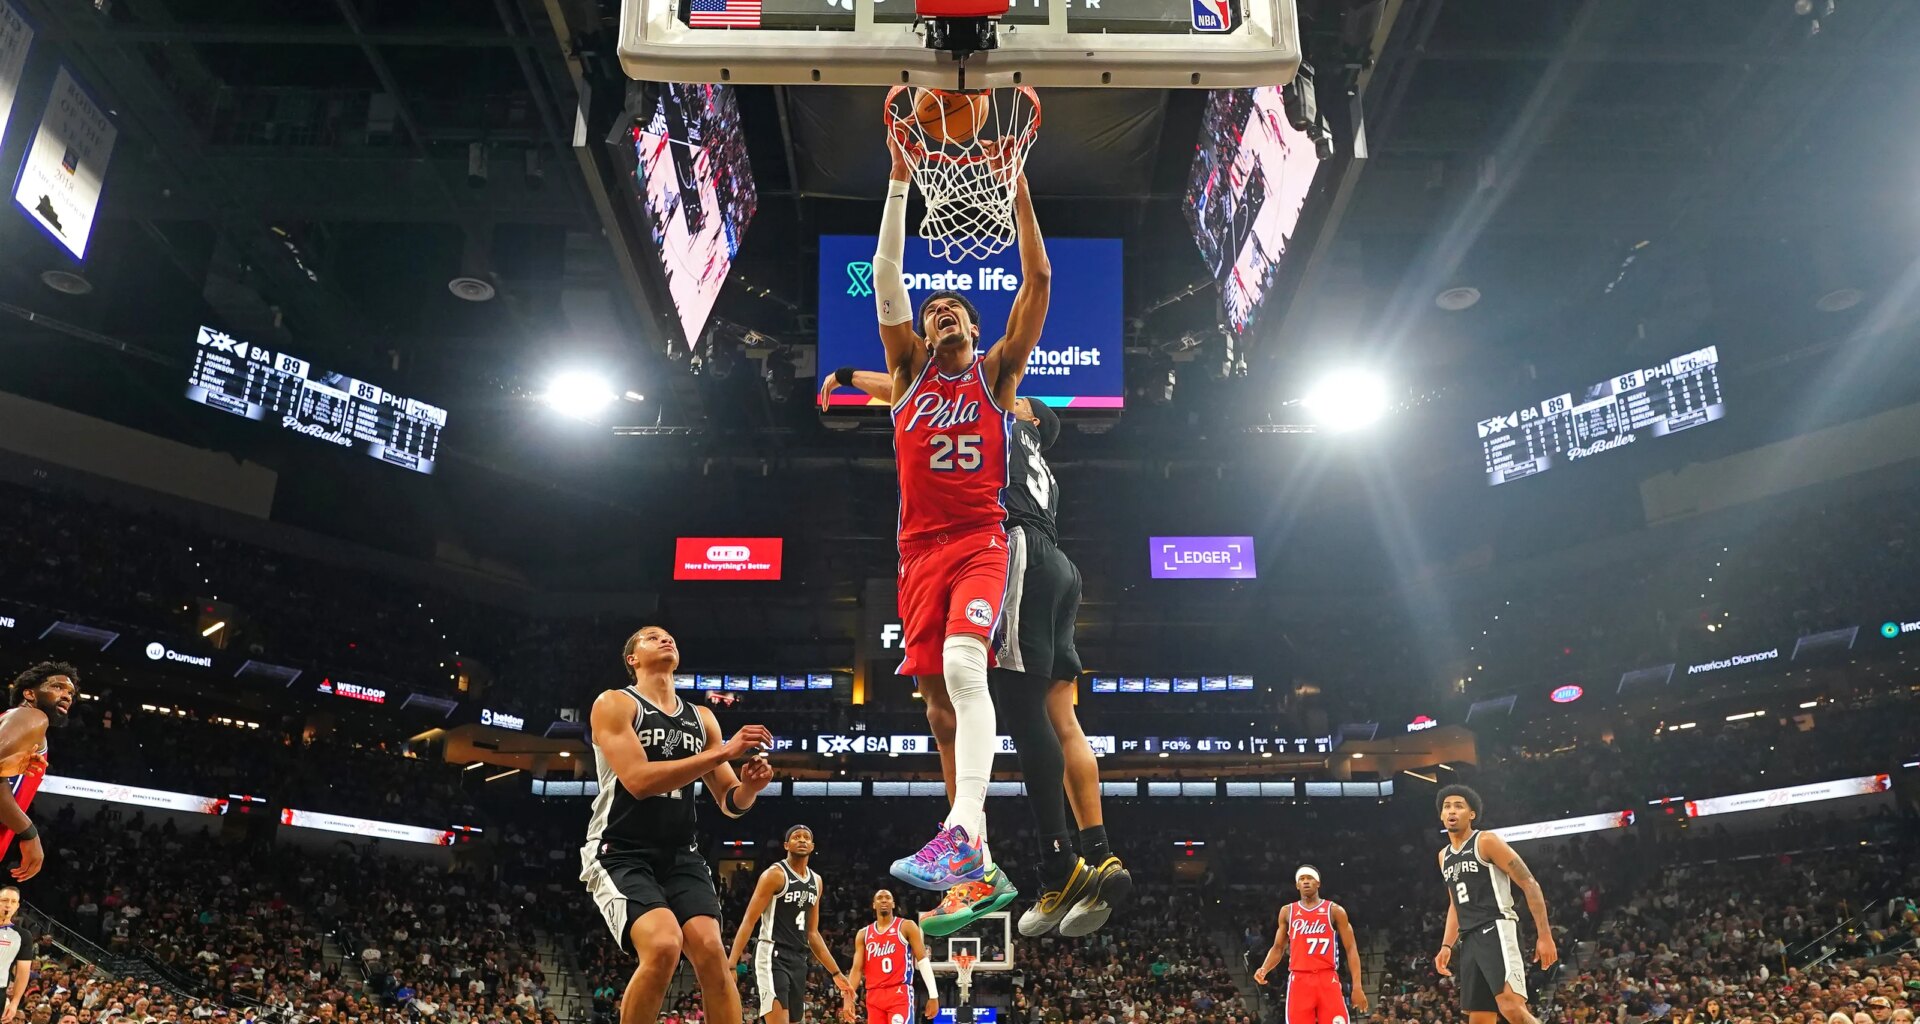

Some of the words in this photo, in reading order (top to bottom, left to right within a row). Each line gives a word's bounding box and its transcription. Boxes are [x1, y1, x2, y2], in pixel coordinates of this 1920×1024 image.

[1198, 15, 1217, 26] NBA
[69, 83, 107, 131] RODEO
[61, 100, 76, 117] OF
[80, 122, 101, 147] THE
[62, 123, 92, 157] YEAR
[53, 169, 74, 191] 2018
[903, 269, 972, 290] onate
[978, 267, 1017, 290] life
[205, 352, 231, 365] HARPER
[249, 346, 272, 364] SA
[281, 357, 301, 374] 89
[1028, 347, 1100, 366] thodist
[200, 374, 225, 386] BRYANT
[202, 366, 215, 375] FOX
[1024, 367, 1070, 375] THCARE
[1618, 374, 1637, 390] 85
[1643, 362, 1672, 381] PHI
[356, 383, 375, 399] 85
[379, 391, 407, 410] PHI
[905, 392, 980, 431] Phila
[1519, 406, 1538, 421] SA
[1547, 397, 1565, 413] 89
[282, 416, 353, 447] ProBaller
[930, 435, 982, 471] 25
[1491, 450, 1503, 458] FOX
[1567, 434, 1636, 461] ProBaller
[703, 563, 746, 571] Everything's
[1175, 551, 1230, 563] LEDGER
[166, 650, 211, 667] Ownwell
[1688, 658, 1731, 674] Americus
[1732, 649, 1778, 666] Diamond
[337, 682, 362, 694] WEST
[362, 687, 386, 698] LOOP
[638, 728, 703, 757] SPURS
[777, 741, 793, 749] PF
[867, 737, 888, 751] SA
[902, 739, 916, 750] 89
[1002, 739, 1015, 750] 85
[1122, 741, 1138, 749] PF
[1162, 740, 1190, 750] FG%
[1215, 741, 1231, 749] TO
[1238, 740, 1244, 750] 4
[1443, 861, 1479, 882] SPURS
[784, 890, 818, 907] SPURS
[1456, 882, 1469, 904] 2
[795, 911, 805, 930] 4
[1292, 918, 1326, 939] Phila
[866, 941, 895, 961] Phila
[1306, 938, 1329, 954] 77
[881, 958, 892, 973] 0
